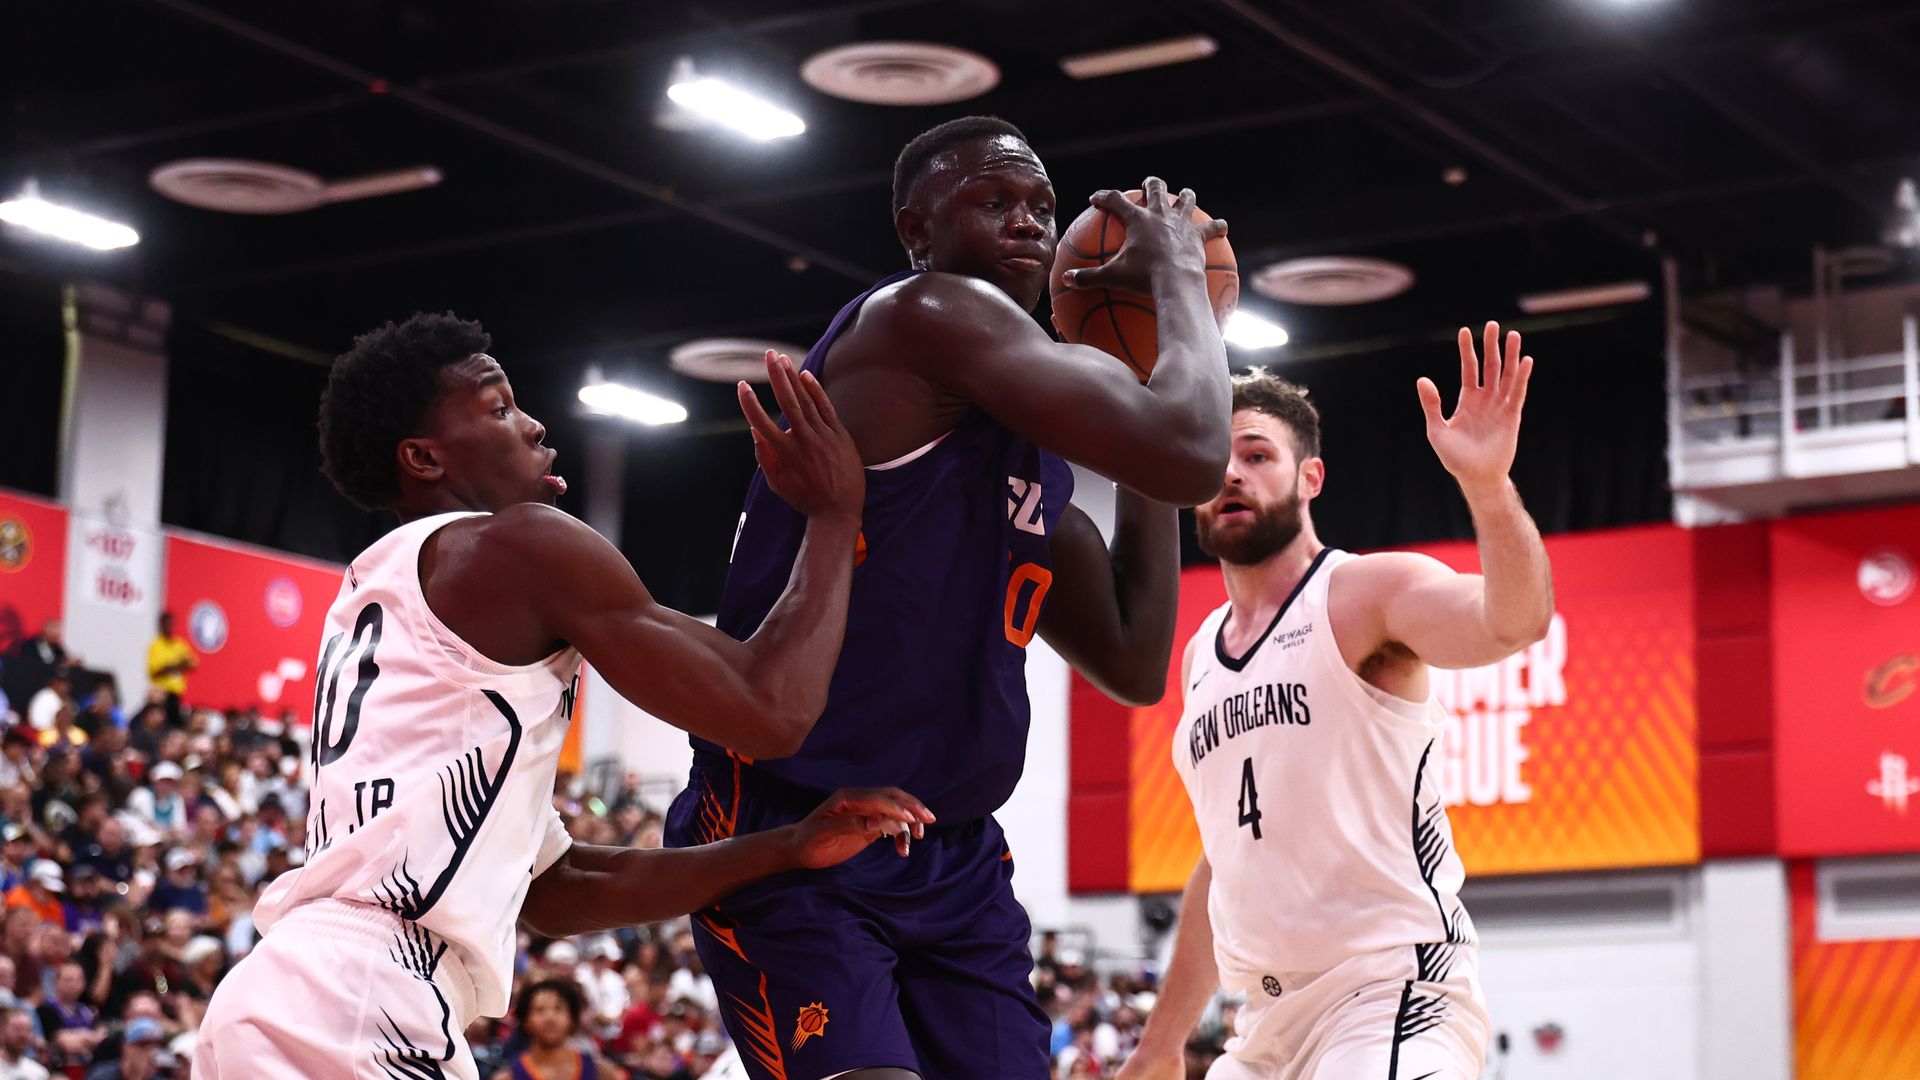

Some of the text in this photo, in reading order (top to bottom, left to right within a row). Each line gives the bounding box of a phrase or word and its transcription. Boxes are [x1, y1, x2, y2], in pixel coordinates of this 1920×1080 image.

[1189, 682, 1311, 770] NEW ORLEANS
[1238, 757, 1262, 840] 4
